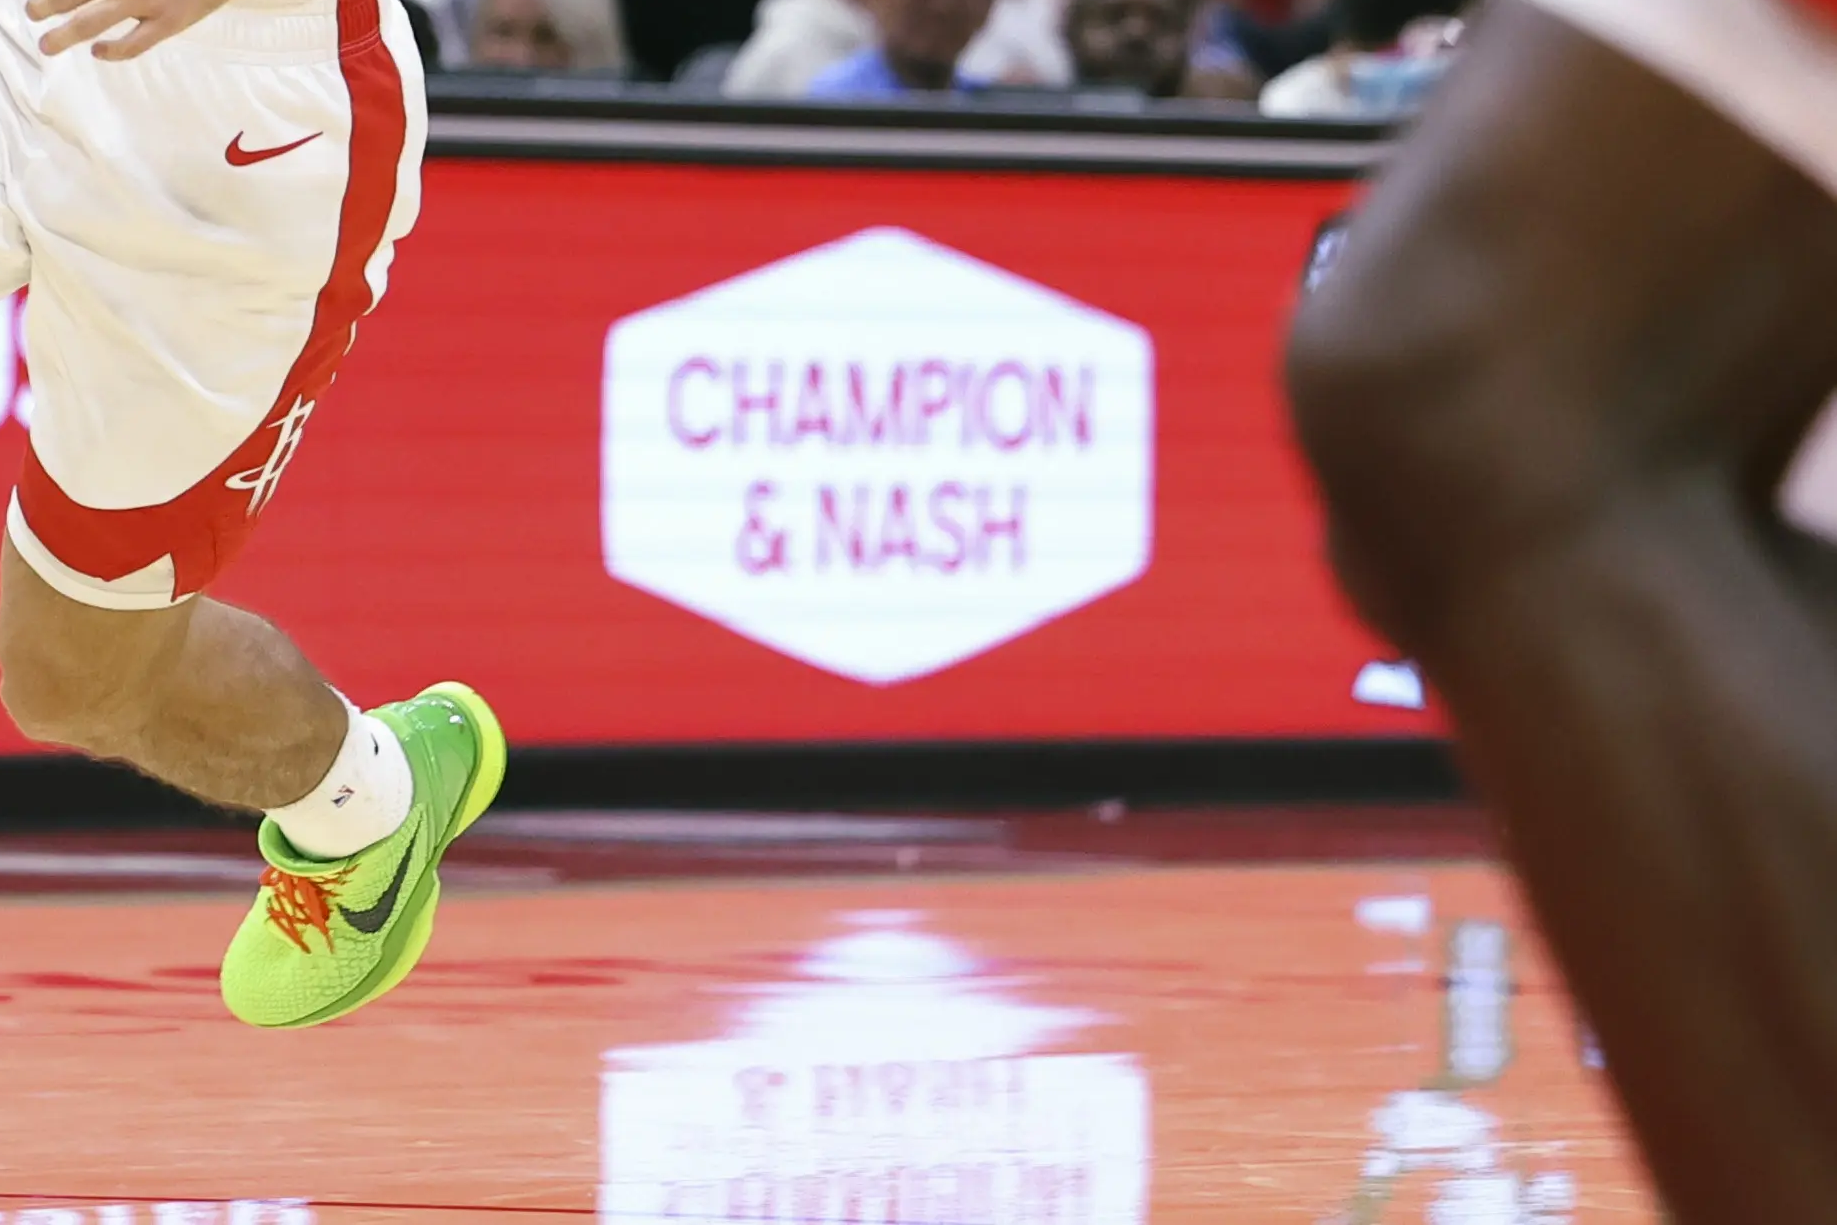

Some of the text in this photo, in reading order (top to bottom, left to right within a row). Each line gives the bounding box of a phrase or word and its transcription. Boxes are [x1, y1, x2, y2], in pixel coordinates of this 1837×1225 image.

[665, 353, 1097, 451] CHAMPION
[735, 480, 1029, 574] & NASH
